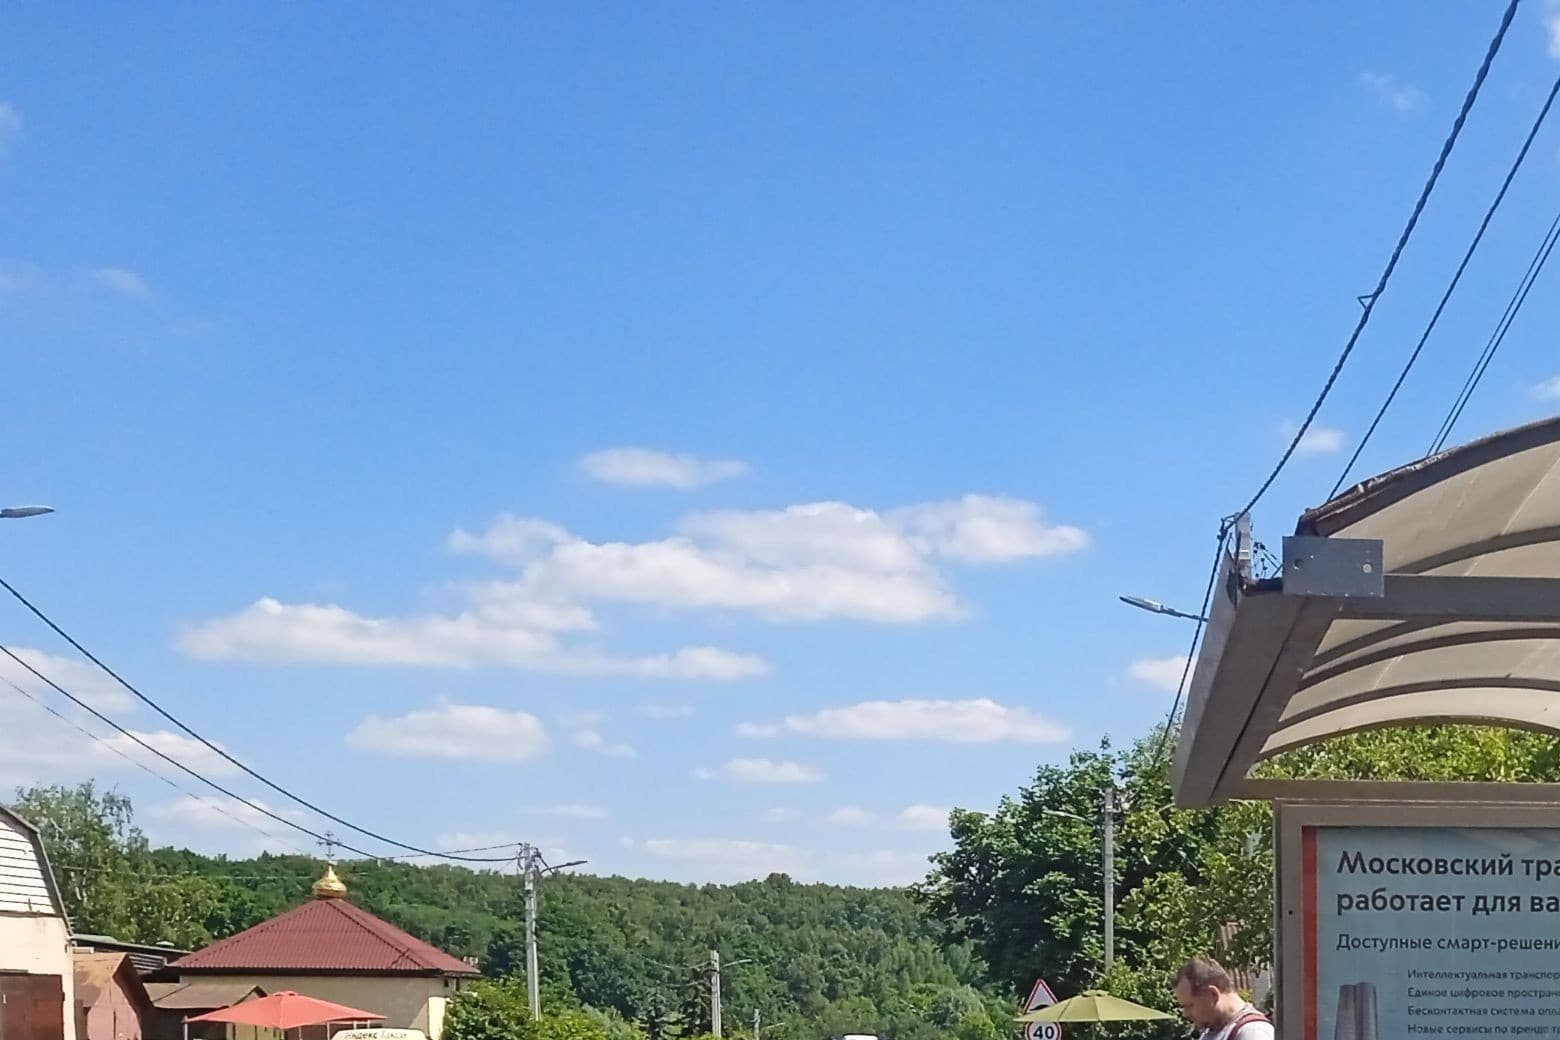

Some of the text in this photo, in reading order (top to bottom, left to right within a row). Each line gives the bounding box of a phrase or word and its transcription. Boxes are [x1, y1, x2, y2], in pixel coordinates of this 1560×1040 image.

[1336, 850, 1514, 876] Московский
[1336, 888, 1465, 916] работает
[1472, 894, 1522, 915] для
[1336, 934, 1432, 952] Доступные
[1407, 969, 1507, 981] Интеллектуальная
[1407, 987, 1447, 998] Единое
[1450, 987, 1505, 999] цифровое
[1407, 1005, 1488, 1016] Бесконтактная
[1490, 1007, 1535, 1016] система
[1033, 1026, 1055, 1040] 40
[1407, 1024, 1443, 1034] Новые
[1446, 1025, 1492, 1035] сервисы
[1494, 1026, 1508, 1034] по
[1510, 1025, 1548, 1035] аренде
